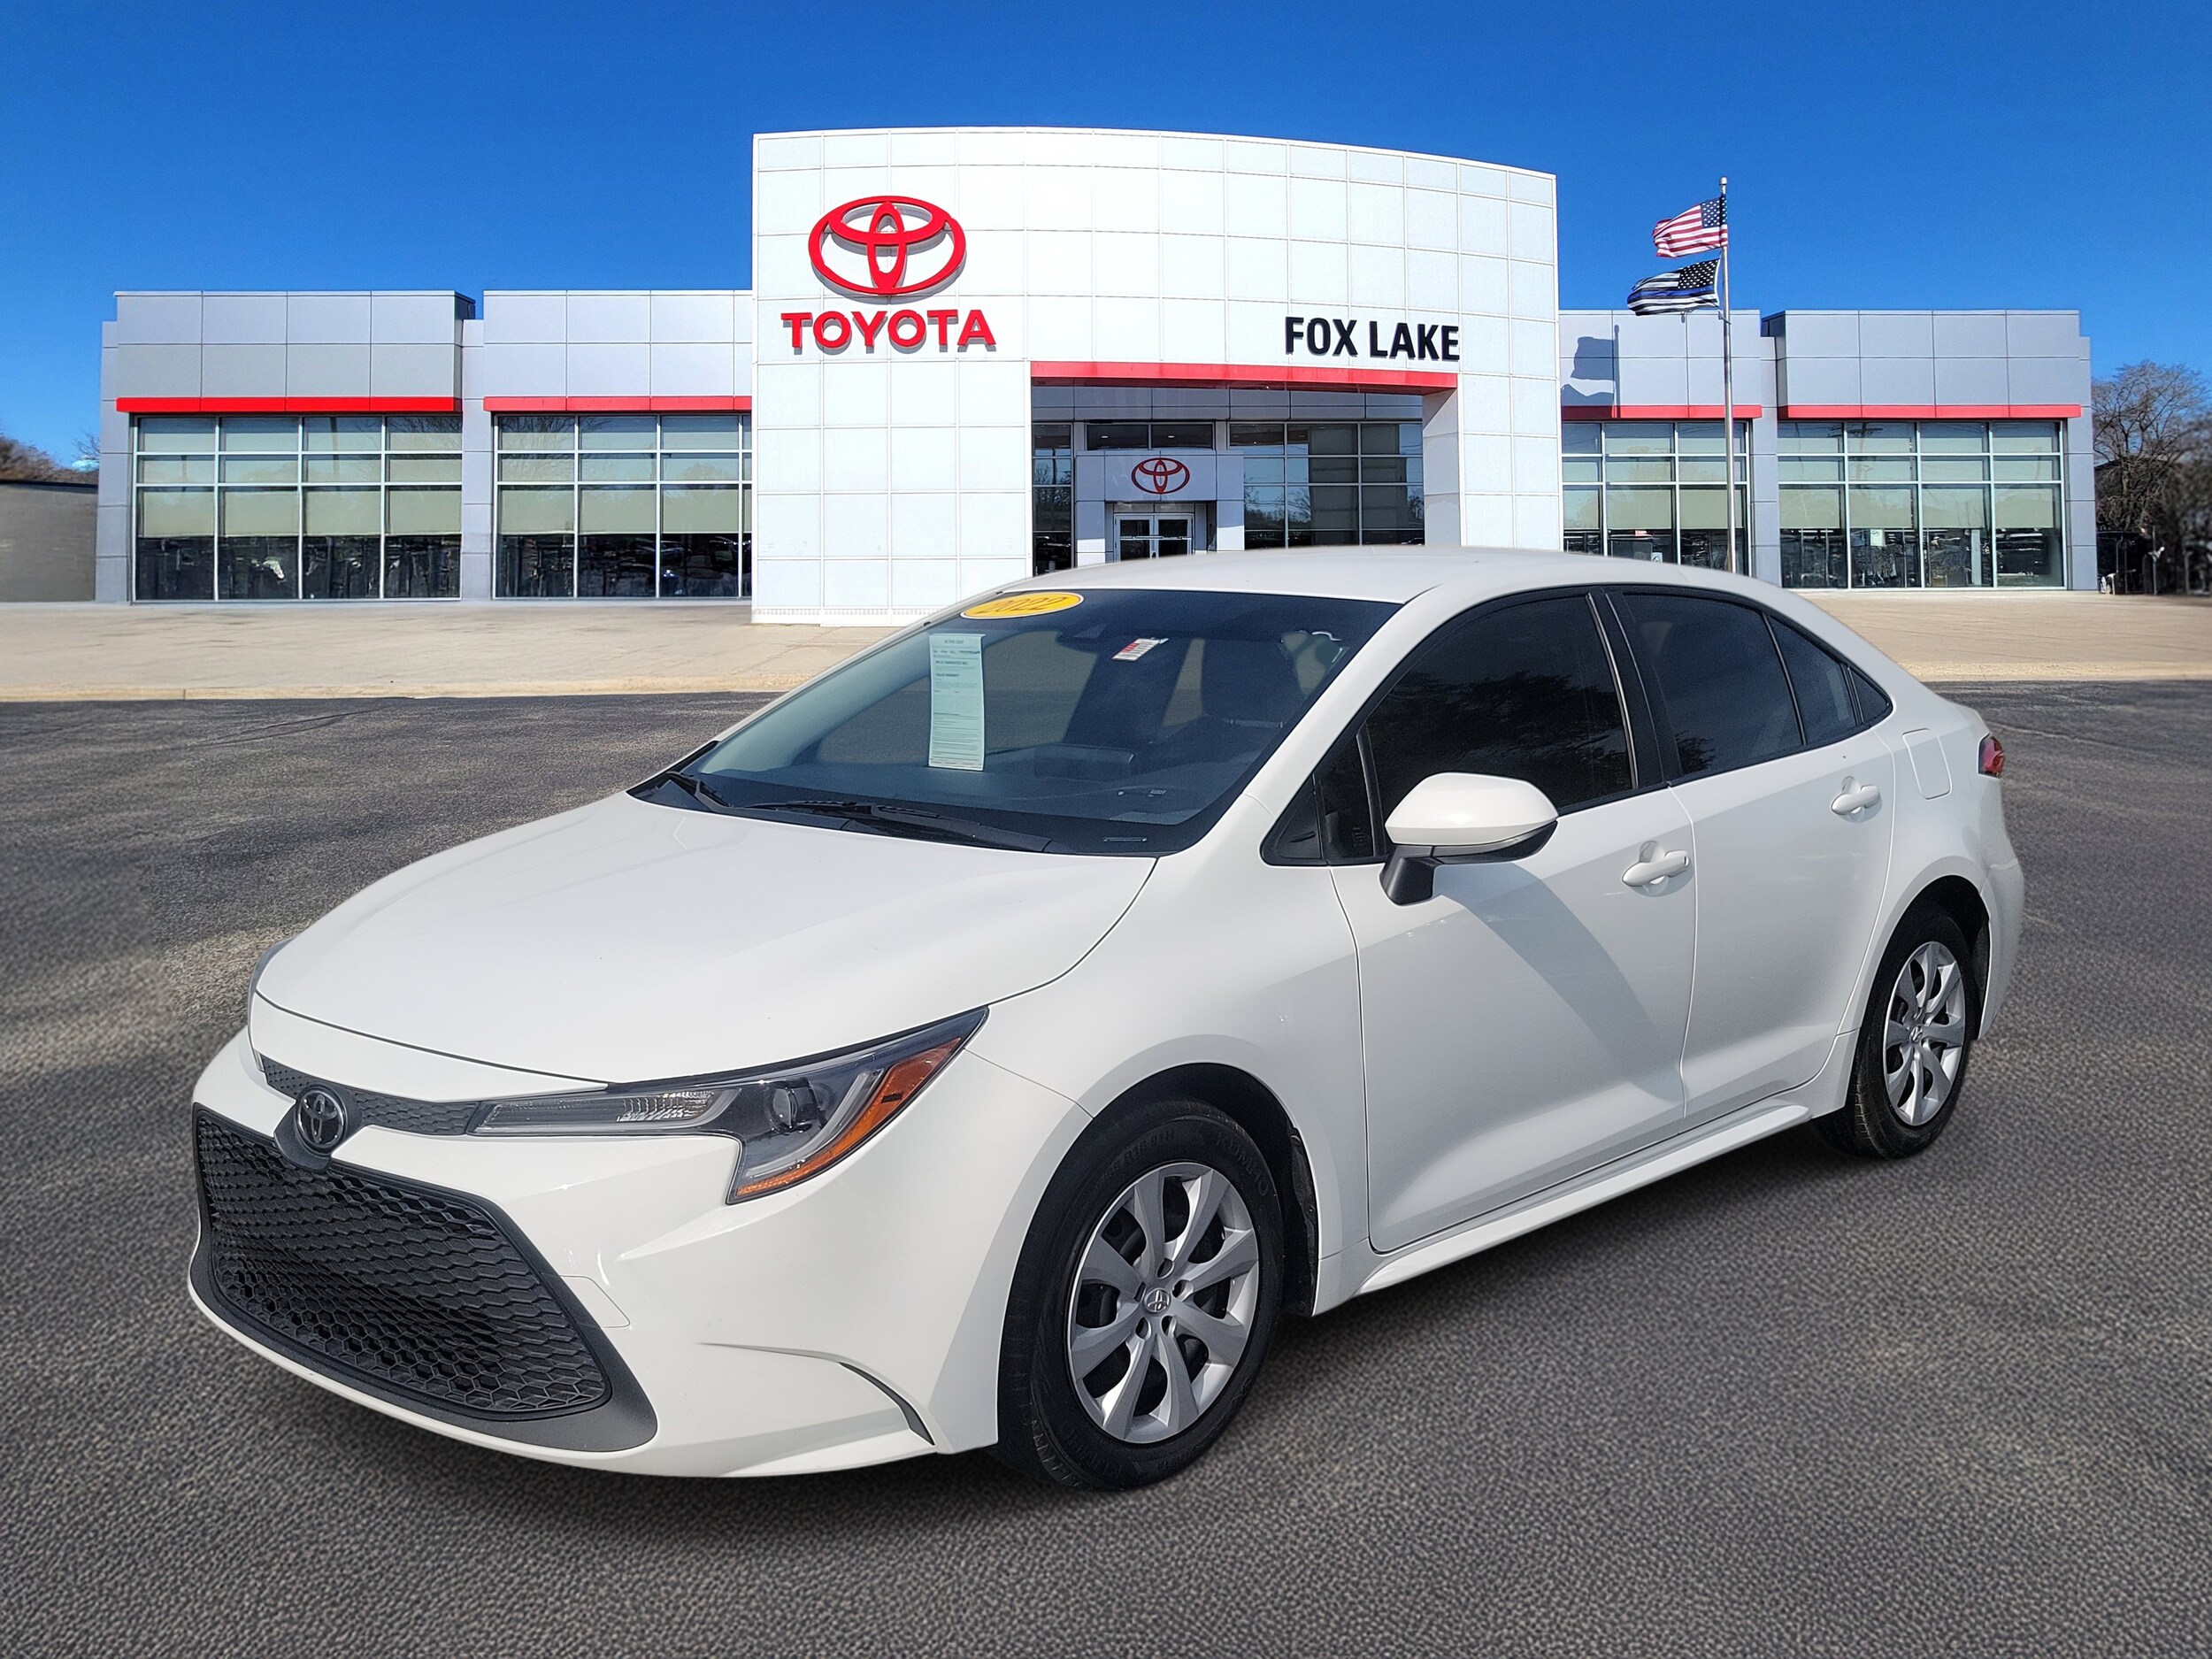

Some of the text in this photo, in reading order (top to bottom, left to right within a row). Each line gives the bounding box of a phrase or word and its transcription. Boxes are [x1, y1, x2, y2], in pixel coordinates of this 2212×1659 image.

[780, 310, 997, 349] TOYOTA
[1286, 317, 1460, 361] FOX LAKE
[973, 596, 1069, 614] 2022
